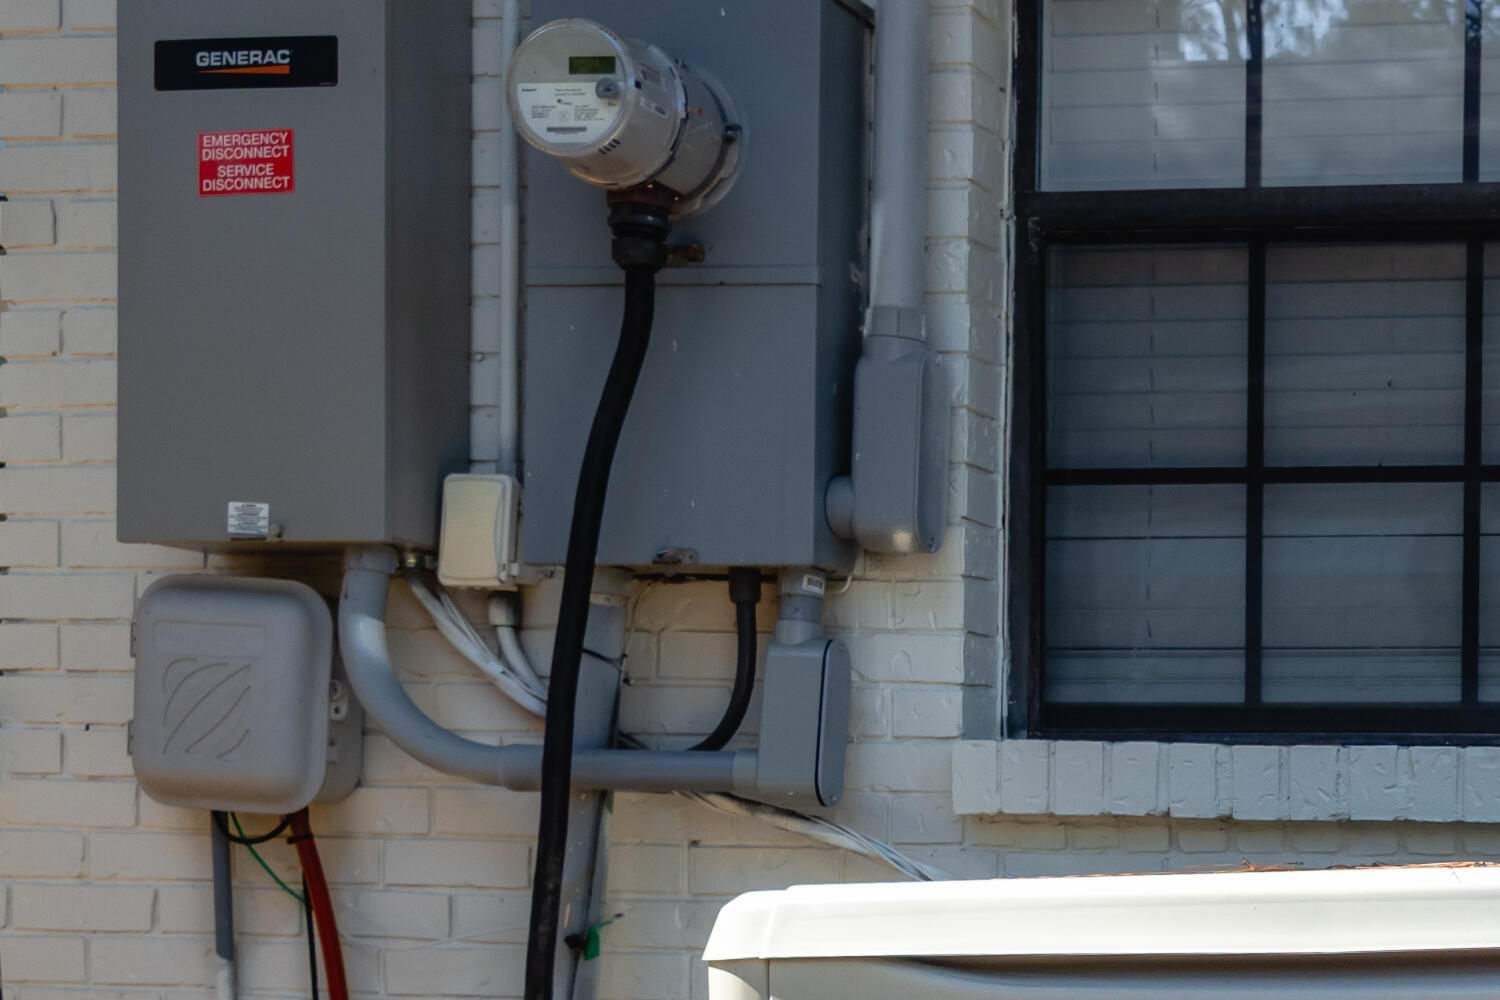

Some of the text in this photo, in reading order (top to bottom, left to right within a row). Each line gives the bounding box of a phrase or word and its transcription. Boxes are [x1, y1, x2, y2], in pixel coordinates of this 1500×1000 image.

[196, 50, 290, 66] GENERAC
[203, 132, 288, 147] EMERGENCY
[202, 145, 290, 161] DISCONNECT
[217, 163, 274, 178] SERVICE
[202, 176, 291, 192] DISCONNECT
